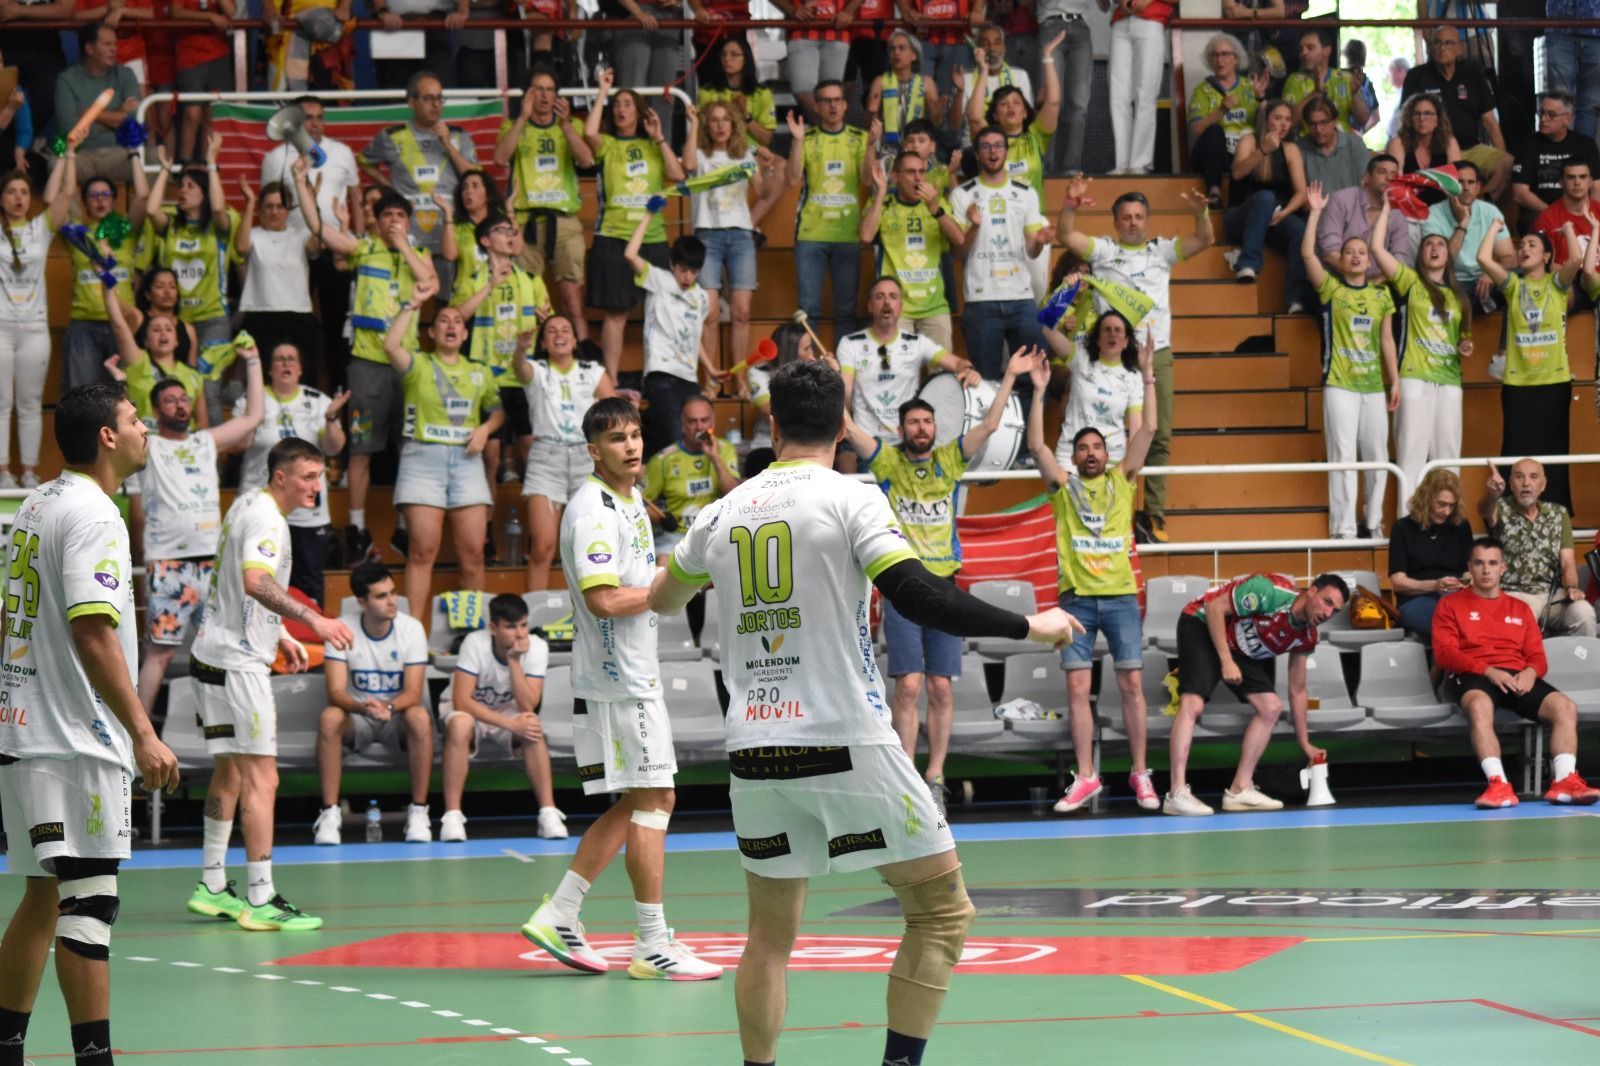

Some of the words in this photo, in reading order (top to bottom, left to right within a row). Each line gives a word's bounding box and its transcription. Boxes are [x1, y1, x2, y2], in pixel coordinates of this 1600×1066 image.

[537, 139, 555, 153] 30
[626, 149, 642, 161] 30
[907, 217, 922, 233] 23
[730, 520, 793, 607] 10
[736, 606, 801, 634] JORTOS
[745, 656, 800, 670] MOLENDUM
[352, 671, 401, 691] CBM
[747, 686, 780, 706] PRO
